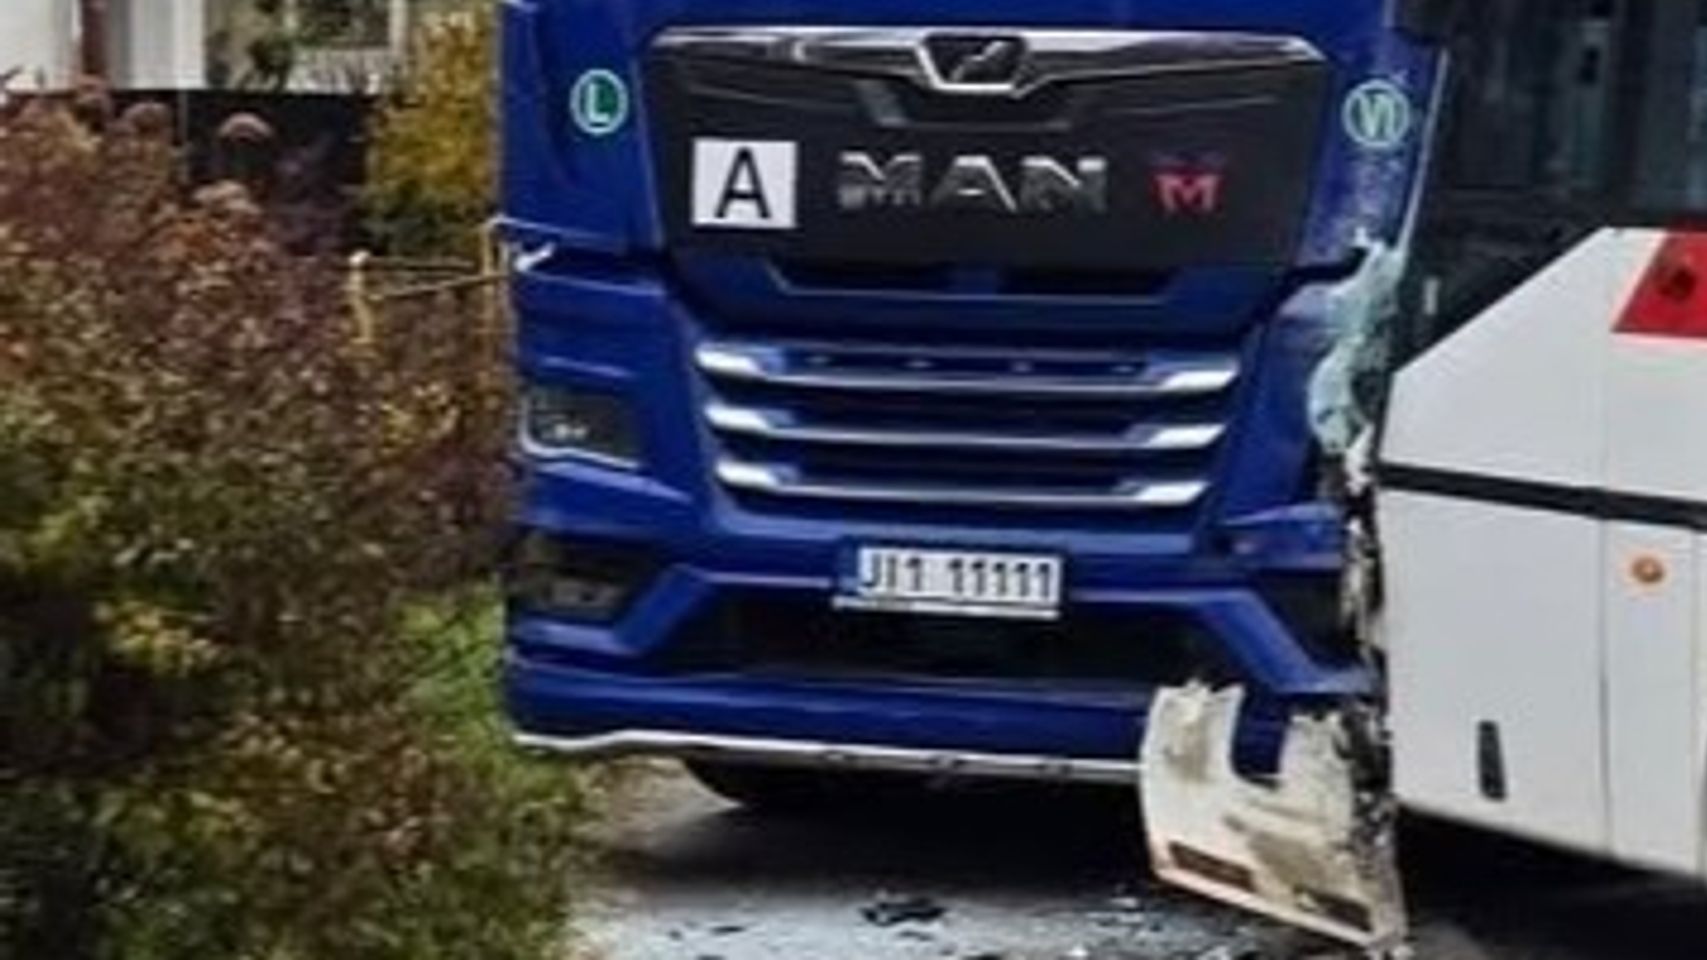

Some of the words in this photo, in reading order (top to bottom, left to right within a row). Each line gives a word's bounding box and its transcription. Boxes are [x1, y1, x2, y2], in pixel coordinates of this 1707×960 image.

[587, 83, 610, 122] L
[715, 146, 770, 219] A
[838, 151, 1107, 212] MAN
[948, 556, 1053, 598] 11111
